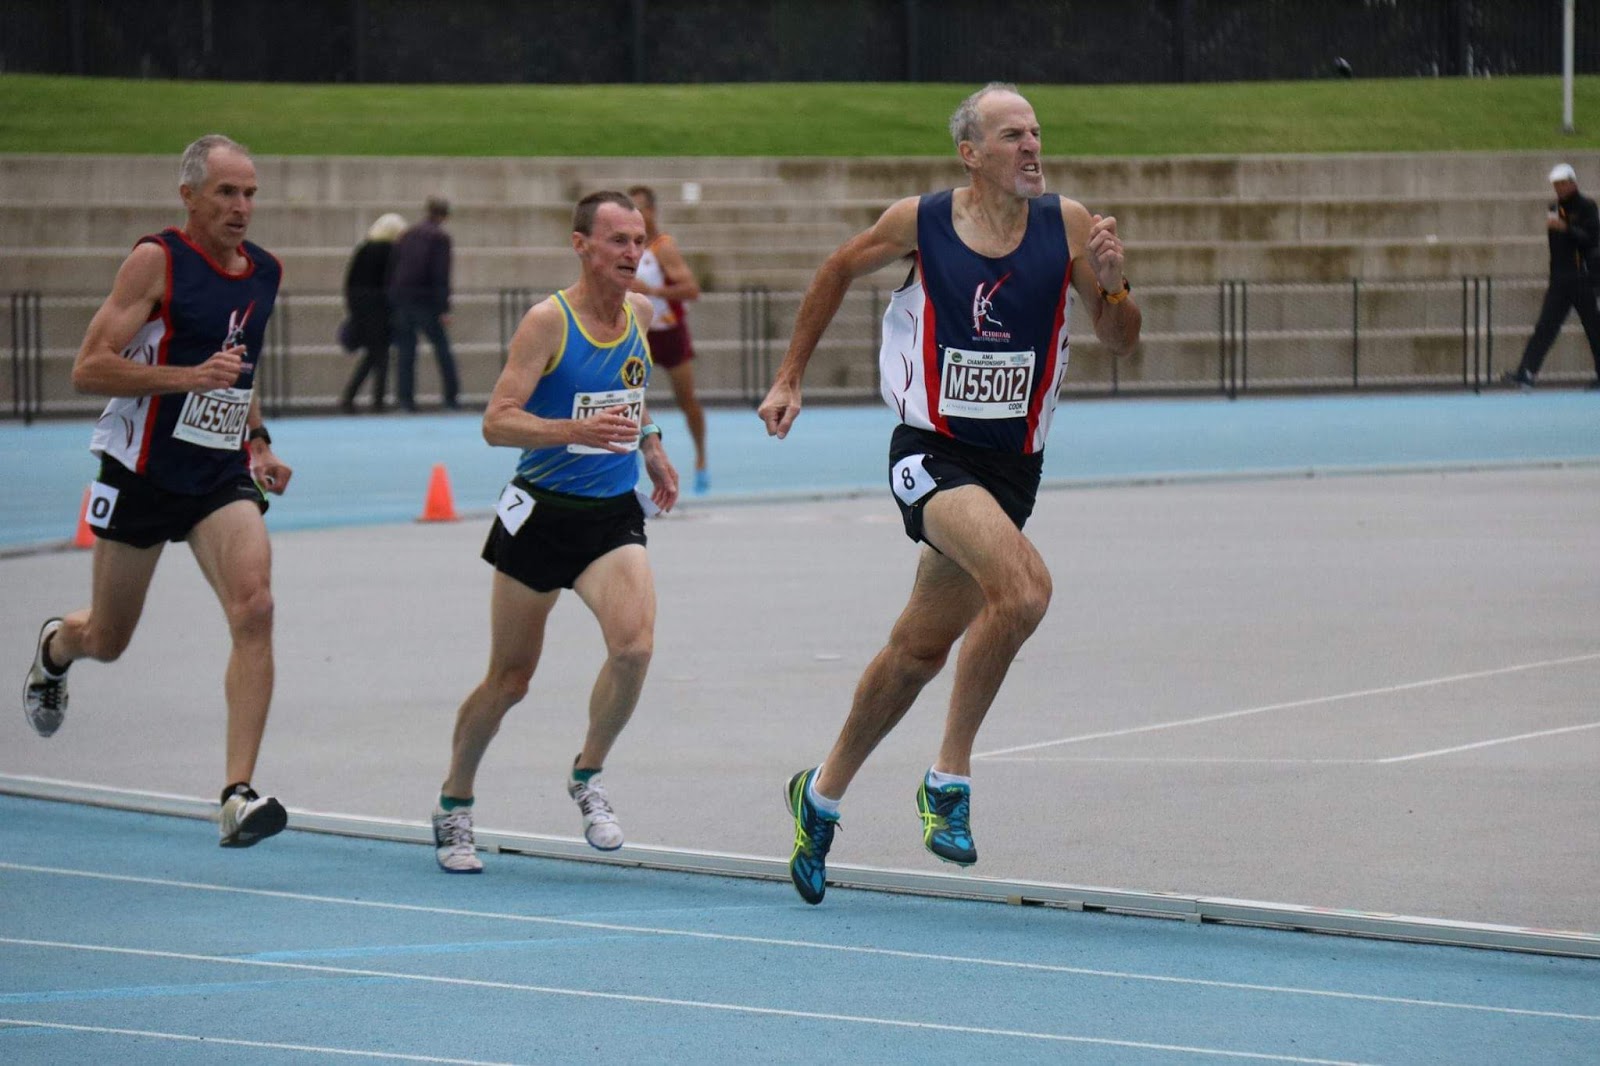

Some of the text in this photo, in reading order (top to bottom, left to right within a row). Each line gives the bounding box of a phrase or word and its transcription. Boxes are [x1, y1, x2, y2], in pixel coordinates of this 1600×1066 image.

[966, 359, 1006, 367] CHAMPIONSHIPS
[948, 365, 1026, 402] M55012
[1008, 402, 1024, 411] COOK
[901, 466, 915, 490] 8
[507, 493, 524, 511] 7
